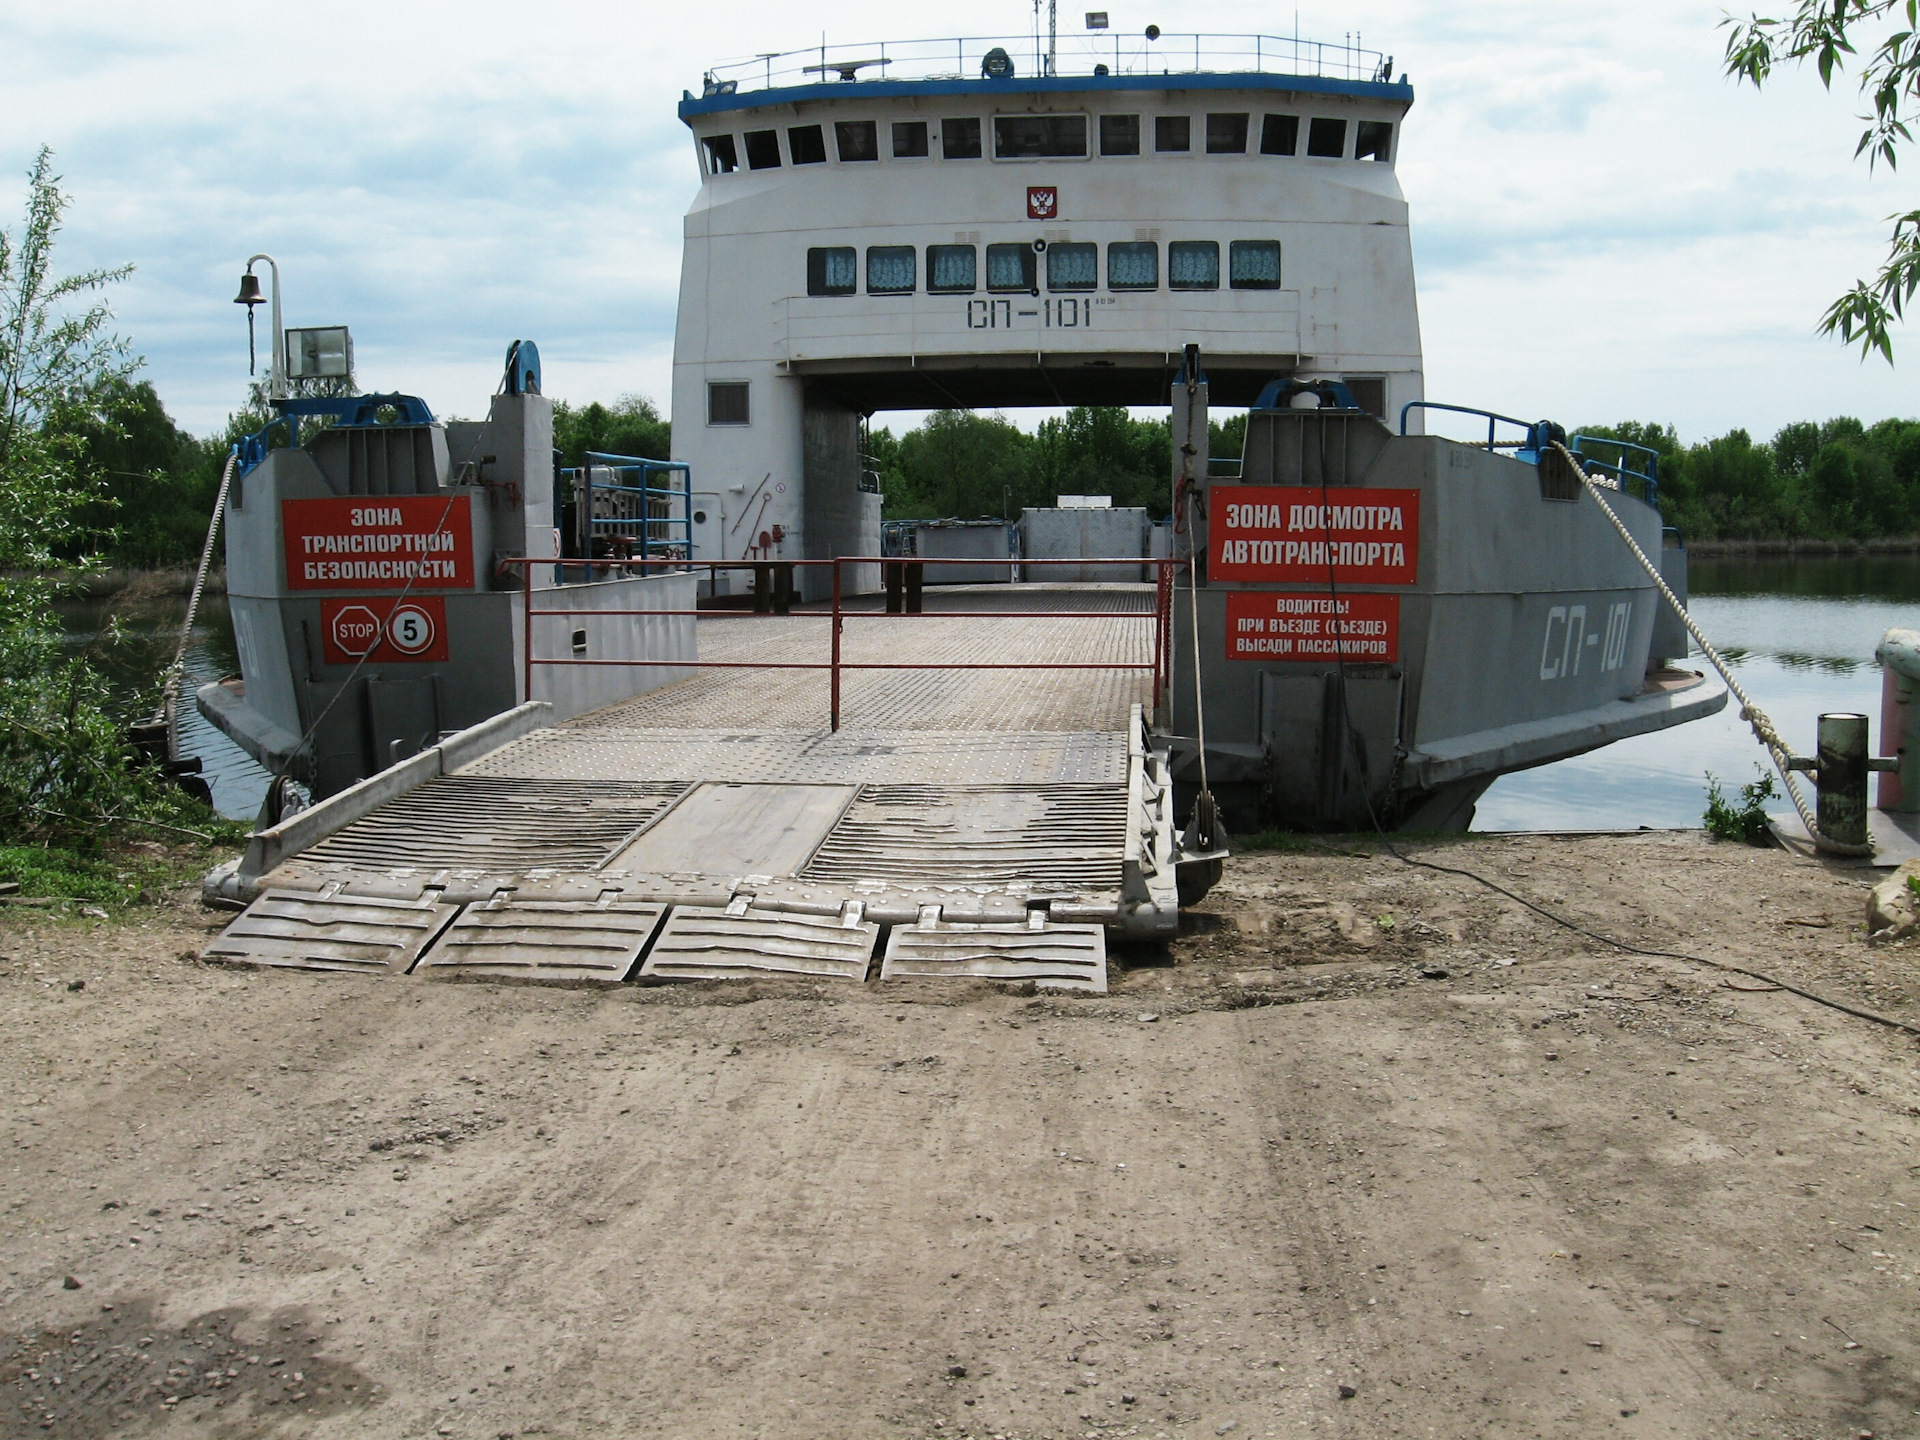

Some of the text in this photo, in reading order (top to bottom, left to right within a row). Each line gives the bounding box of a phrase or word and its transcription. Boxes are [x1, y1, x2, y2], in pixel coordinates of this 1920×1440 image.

[967, 298, 1090, 328] СП-101
[350, 508, 403, 527] ЗОНА
[1226, 503, 1403, 533] ЗОНА ДОСМОТРА
[301, 530, 455, 554] ТРАНСПОРТНОЙ
[1221, 540, 1405, 567] АВТОТРАНСПОРТА
[304, 560, 456, 580] БЕЗОПАСНОСТИ
[1276, 598, 1350, 615] ВОДИТЕЛЬ!
[339, 623, 374, 639] STOP
[403, 619, 418, 641] 5
[1237, 618, 1387, 636] ПРИ ВЪЕЗДЕ (СЪЕЗДЕ)
[1236, 638, 1387, 656] ВЫСАДИ ПАССАЖИРОВ
[1539, 602, 1632, 680] СП-101
